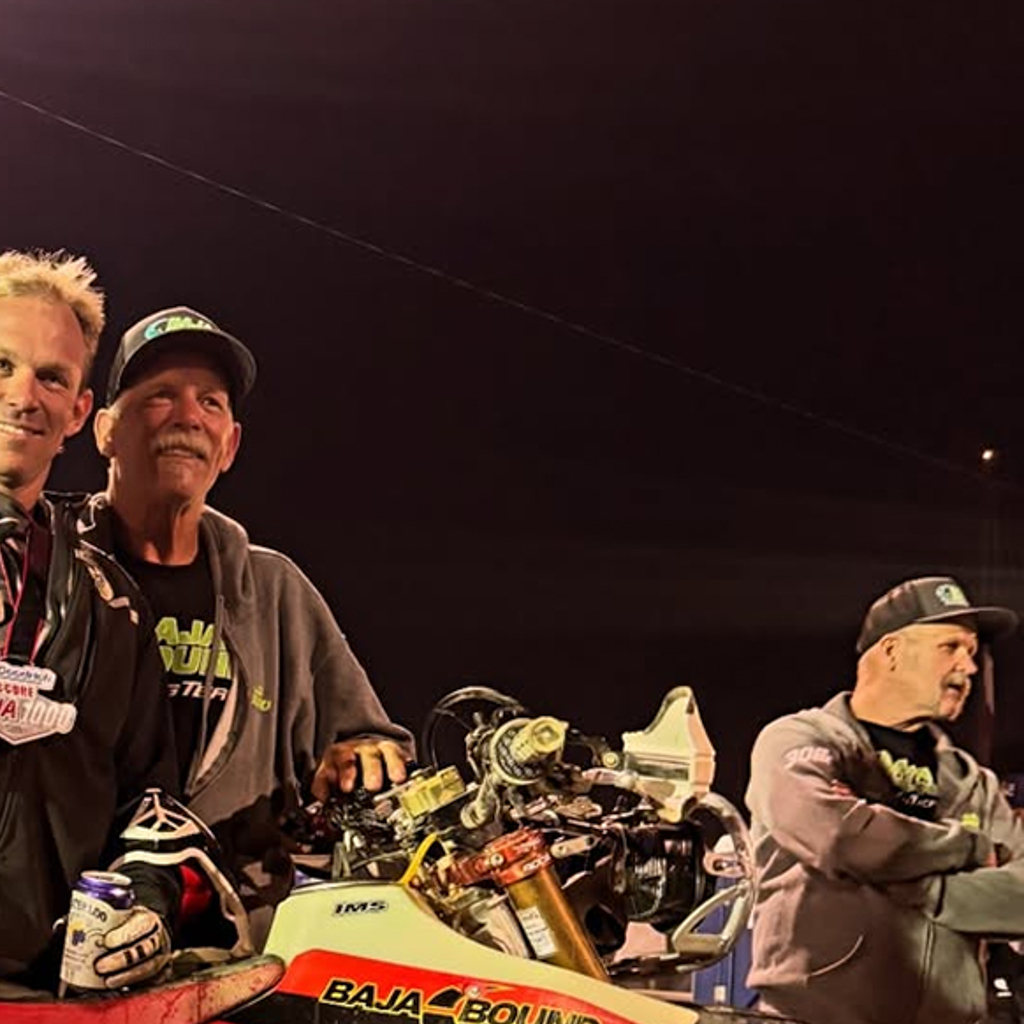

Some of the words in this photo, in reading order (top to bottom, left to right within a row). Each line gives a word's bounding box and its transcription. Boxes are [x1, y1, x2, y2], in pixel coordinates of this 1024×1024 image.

[20, 700, 74, 733] 1000
[332, 900, 388, 916] IMS
[318, 977, 422, 1017] BAJA
